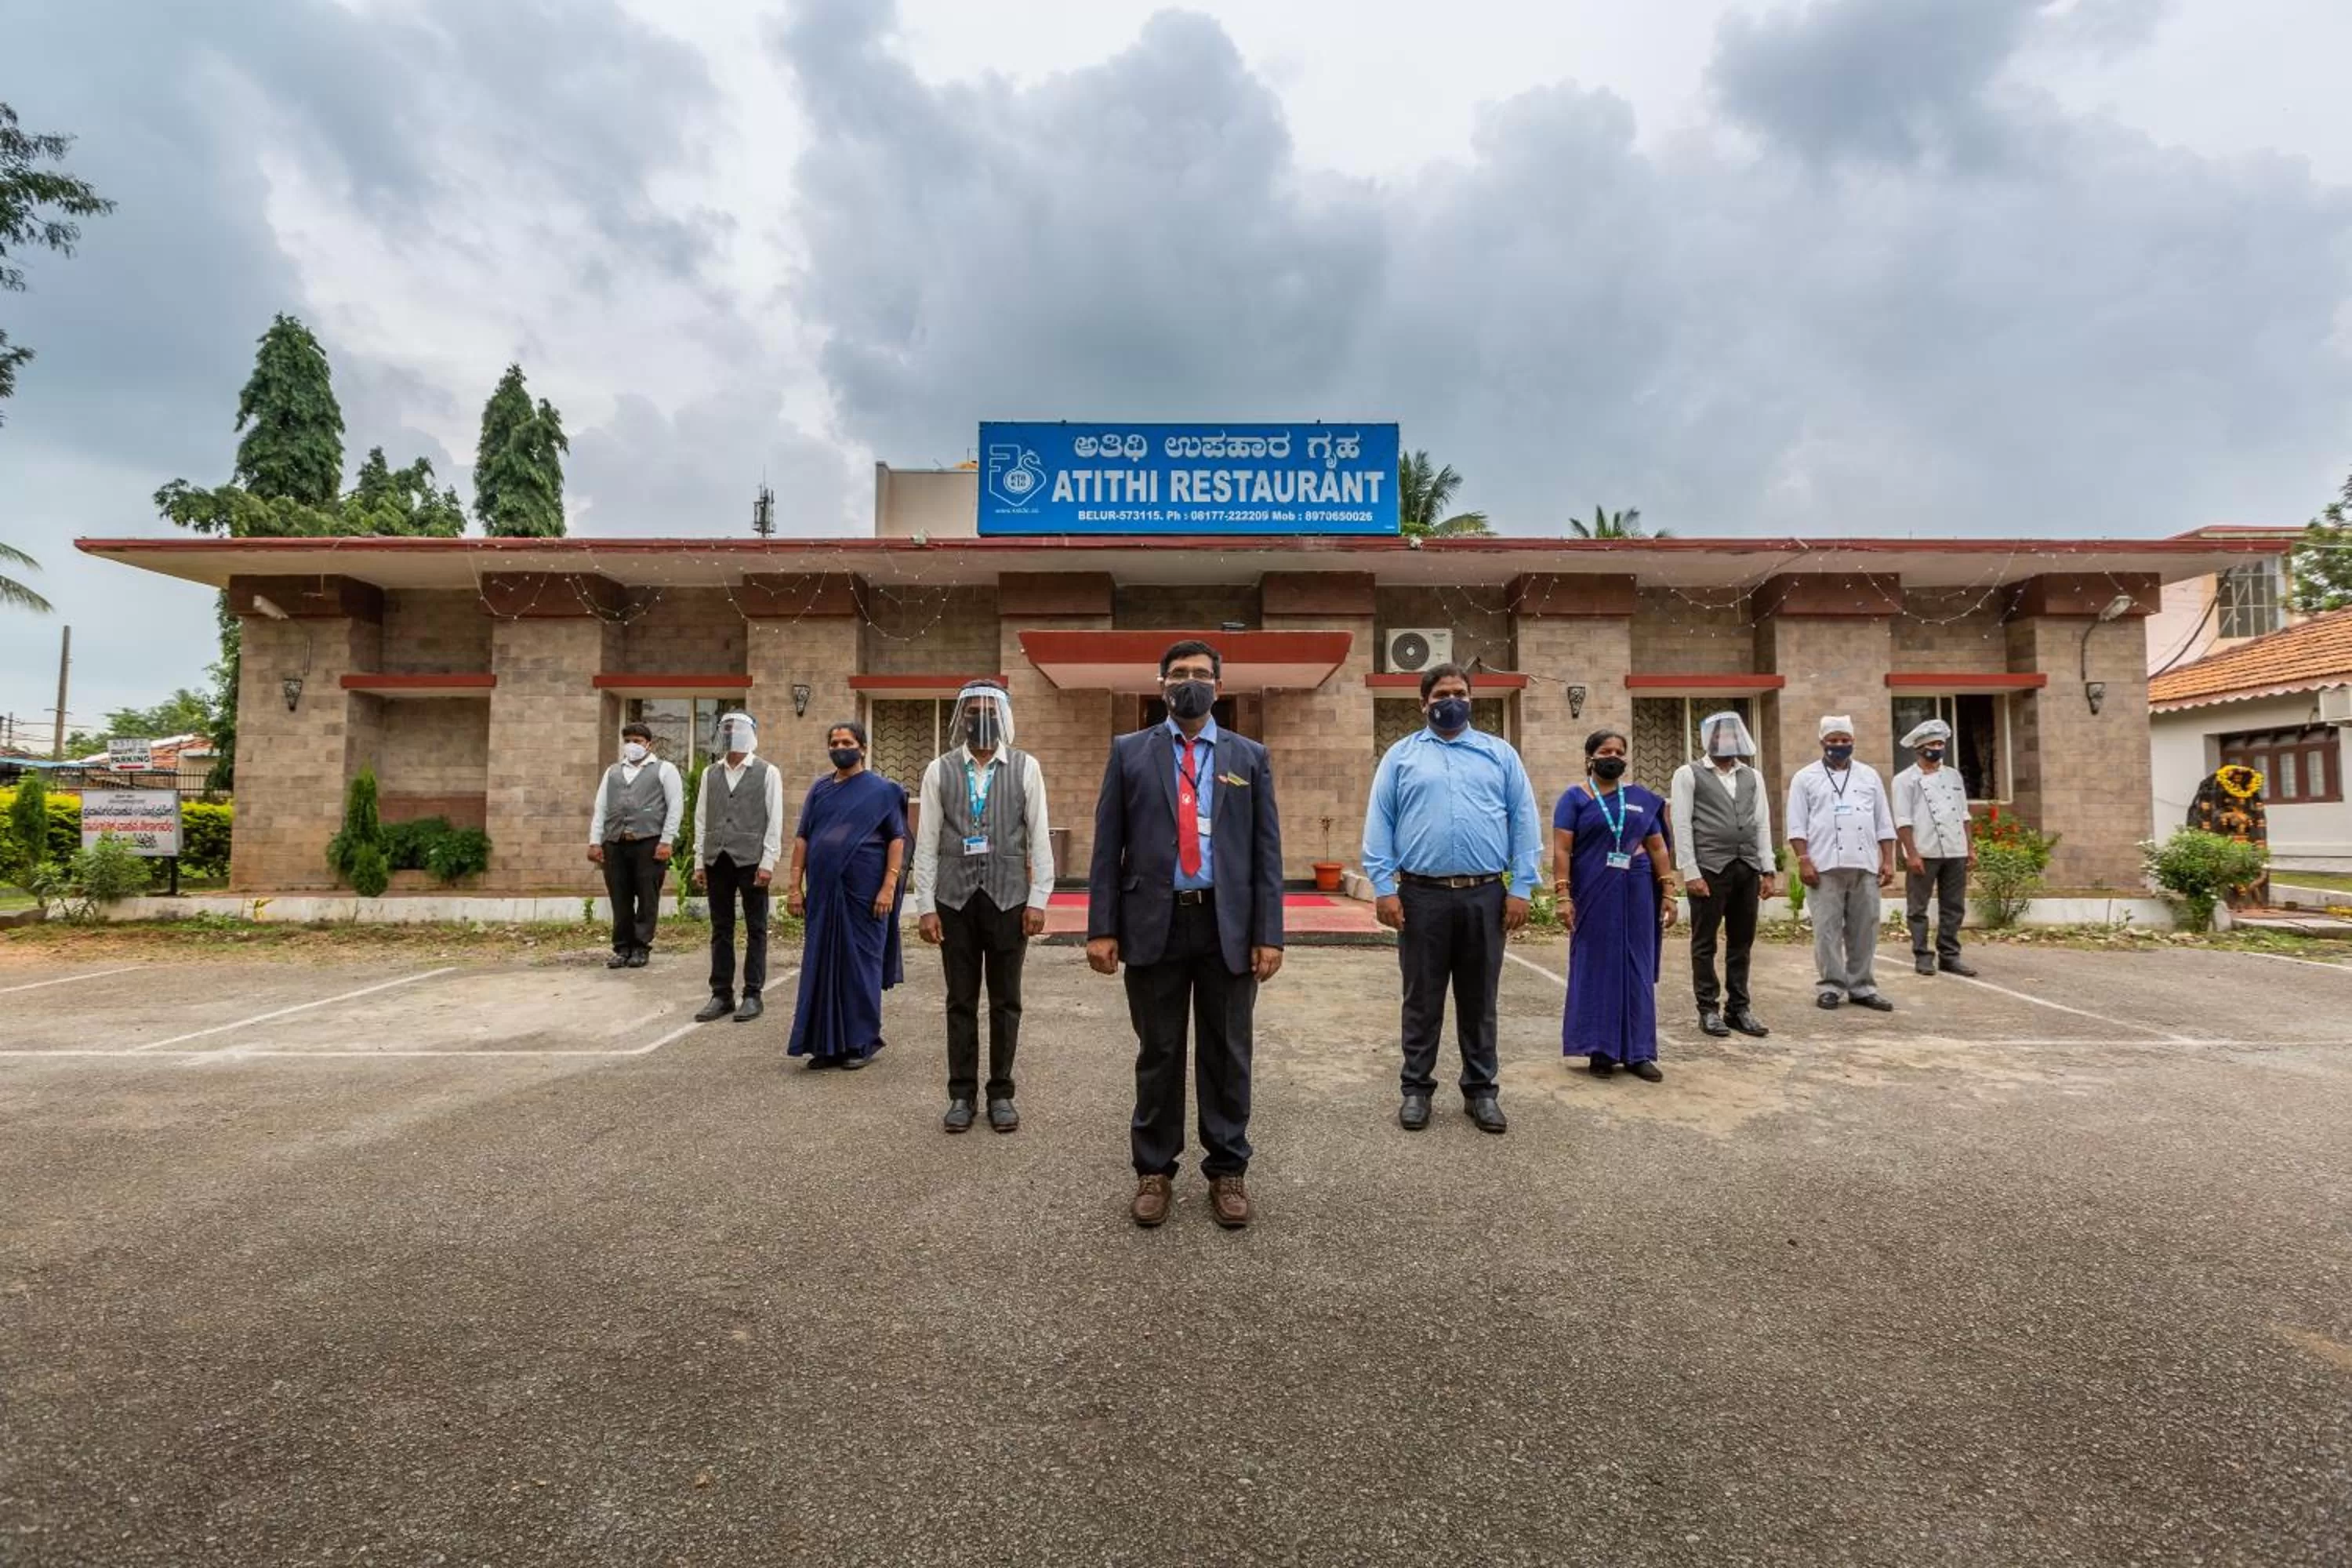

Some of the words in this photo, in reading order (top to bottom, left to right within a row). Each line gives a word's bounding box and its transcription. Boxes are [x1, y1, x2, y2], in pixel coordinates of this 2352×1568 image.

[1165, 430, 1290, 458] ಉಪಹಾರ
[1308, 431, 1359, 469] ಗೃಹ
[1052, 470, 1158, 503] ATITHI
[1171, 470, 1385, 503] RESTAURANT
[1167, 511, 1181, 521] Ph
[1272, 510, 1295, 521] Mob
